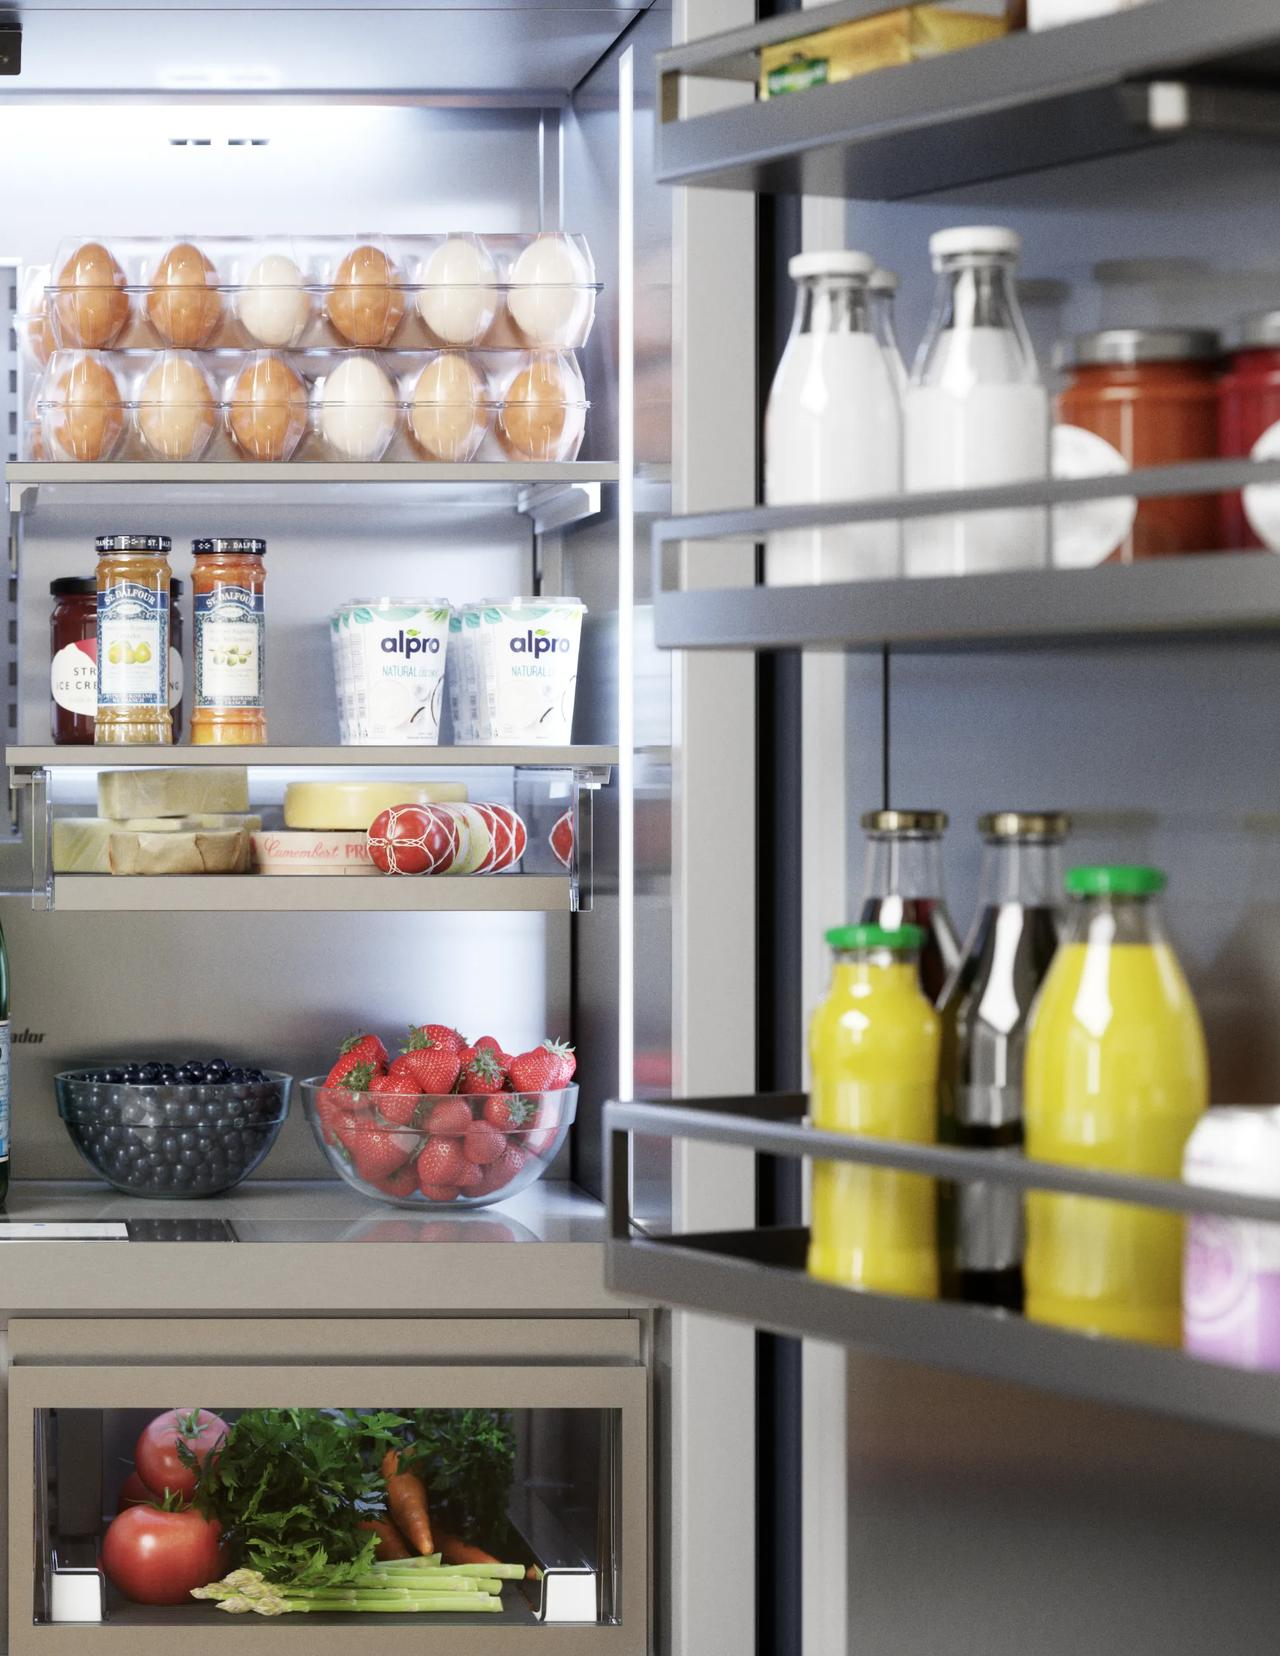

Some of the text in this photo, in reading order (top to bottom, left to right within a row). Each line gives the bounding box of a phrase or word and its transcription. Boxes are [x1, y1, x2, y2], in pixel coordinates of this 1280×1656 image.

[116, 588, 156, 605] DALFOUR
[218, 592, 256, 608] DALFOUR
[381, 629, 440, 659] alpro
[509, 629, 570, 659] alpro
[382, 666, 417, 678] NATURAL
[511, 665, 546, 677] NATURAL
[264, 837, 338, 858] Camembert
